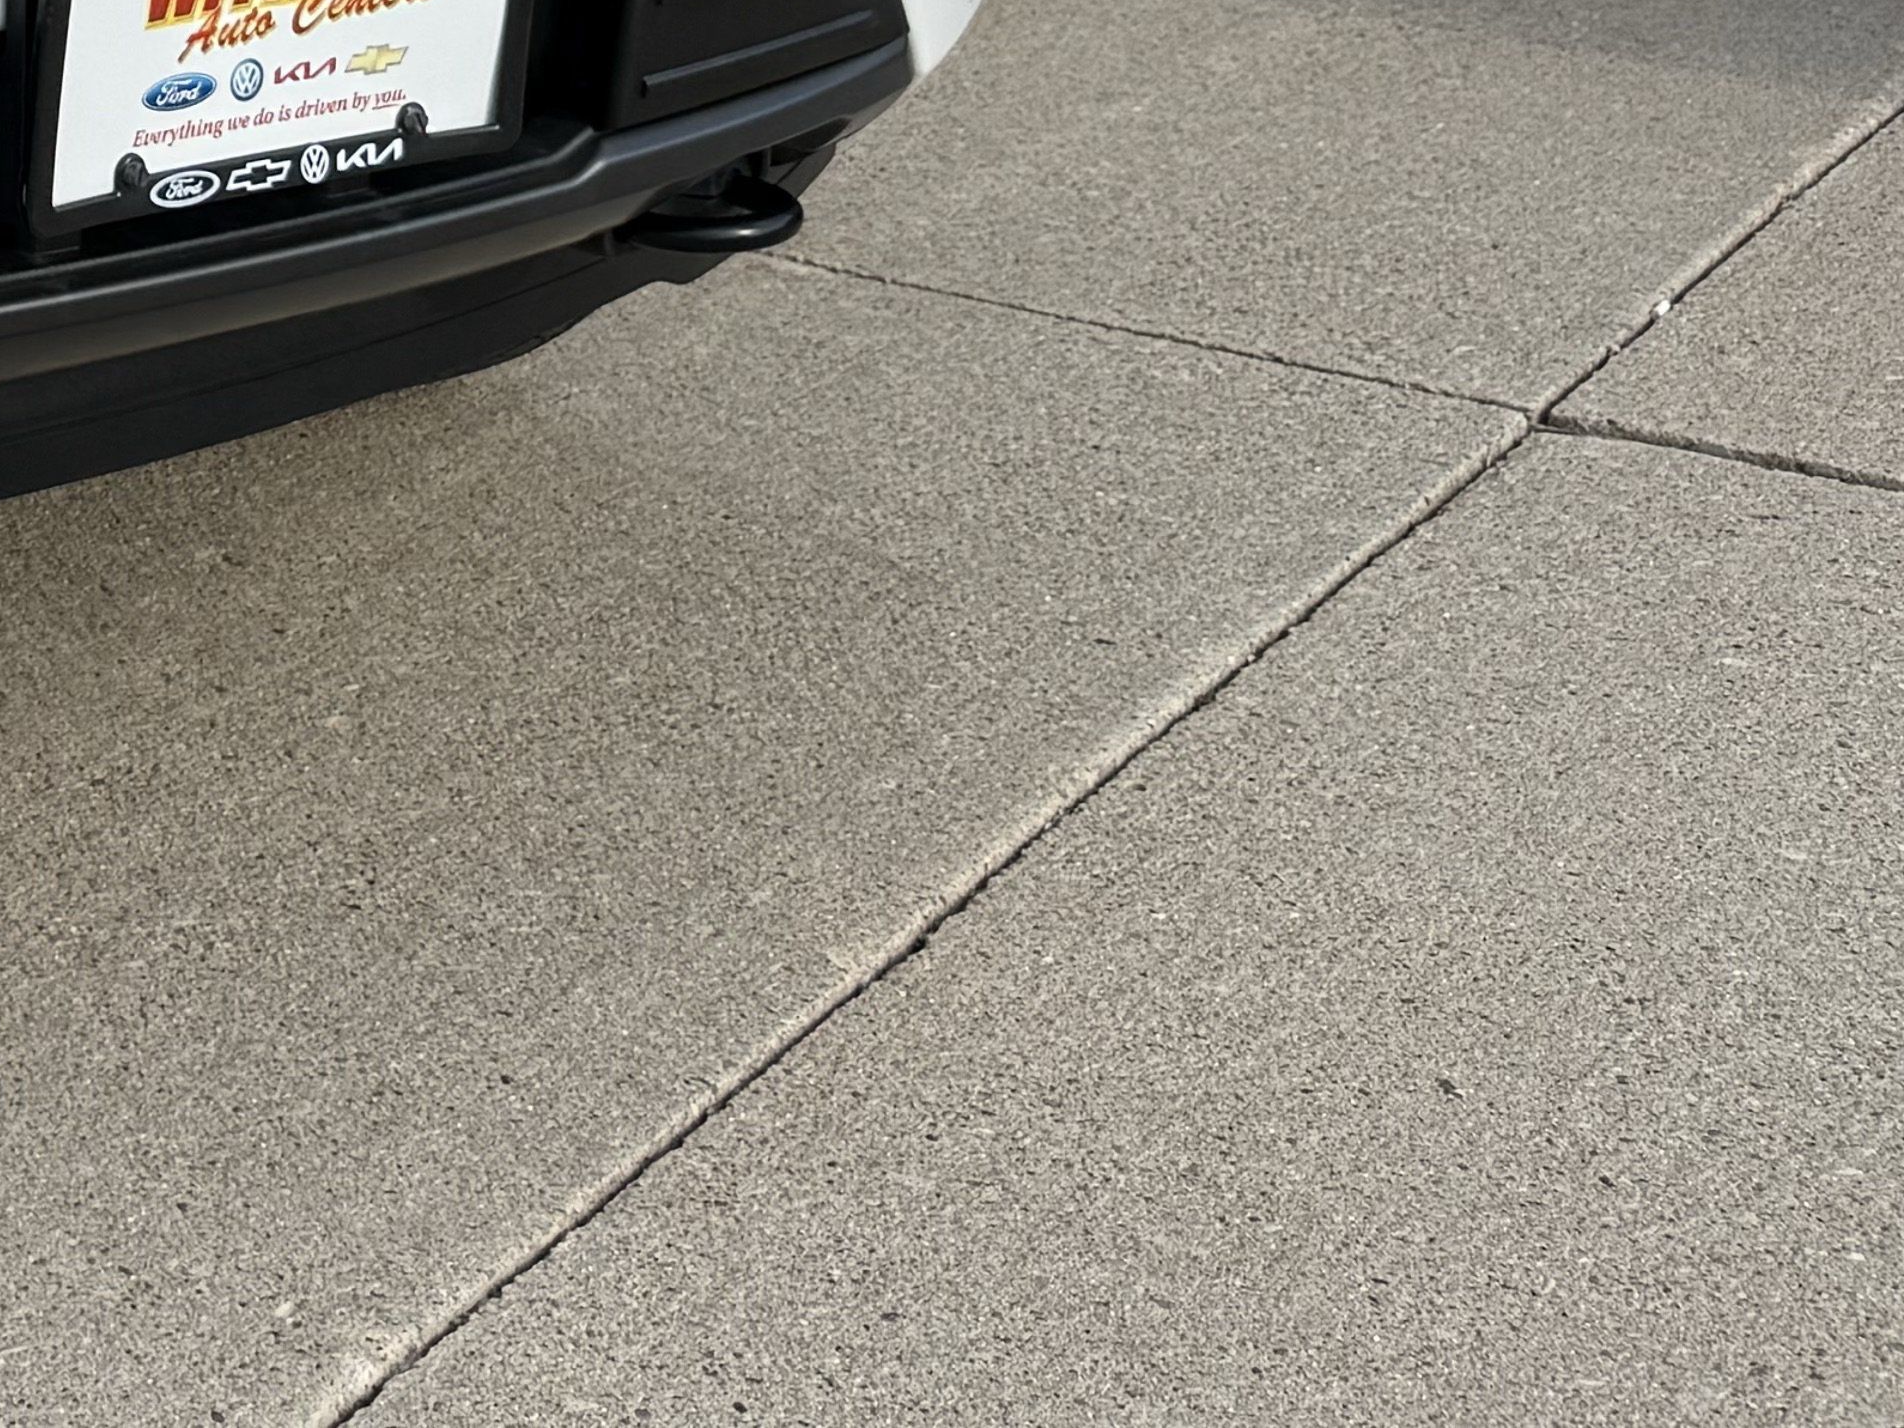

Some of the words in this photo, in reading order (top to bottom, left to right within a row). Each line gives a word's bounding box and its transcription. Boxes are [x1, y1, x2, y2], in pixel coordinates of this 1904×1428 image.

[178, 6, 277, 63] Auto
[132, 118, 224, 147] Everything
[227, 114, 251, 131] we
[252, 107, 274, 124] do
[278, 103, 292, 122] is
[294, 98, 348, 119] driven
[352, 91, 372, 112] by
[372, 88, 407, 110] you.
